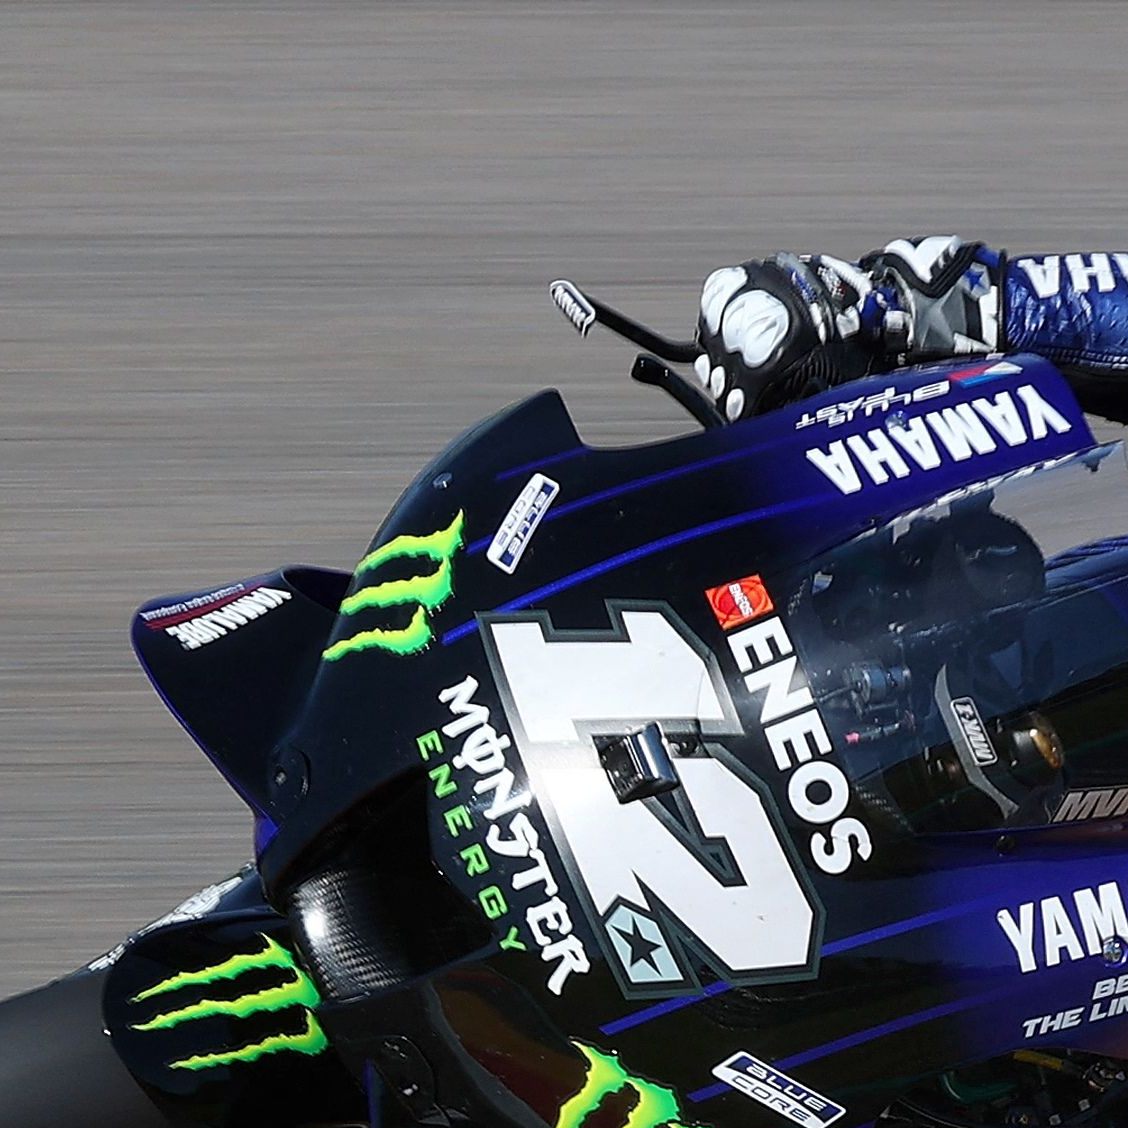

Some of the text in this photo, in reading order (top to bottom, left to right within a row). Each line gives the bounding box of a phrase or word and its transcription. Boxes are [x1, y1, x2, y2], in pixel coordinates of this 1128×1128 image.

[806, 384, 1072, 495] YAMAHA
[165, 587, 292, 650] YAMALUBE
[727, 615, 873, 875] ENEOS
[416, 729, 527, 953] ENERGY
[438, 675, 591, 997] MONSTER
[1022, 1007, 1085, 1039] THE
[732, 1075, 812, 1122] CORE
[746, 1063, 828, 1112] BLUE
